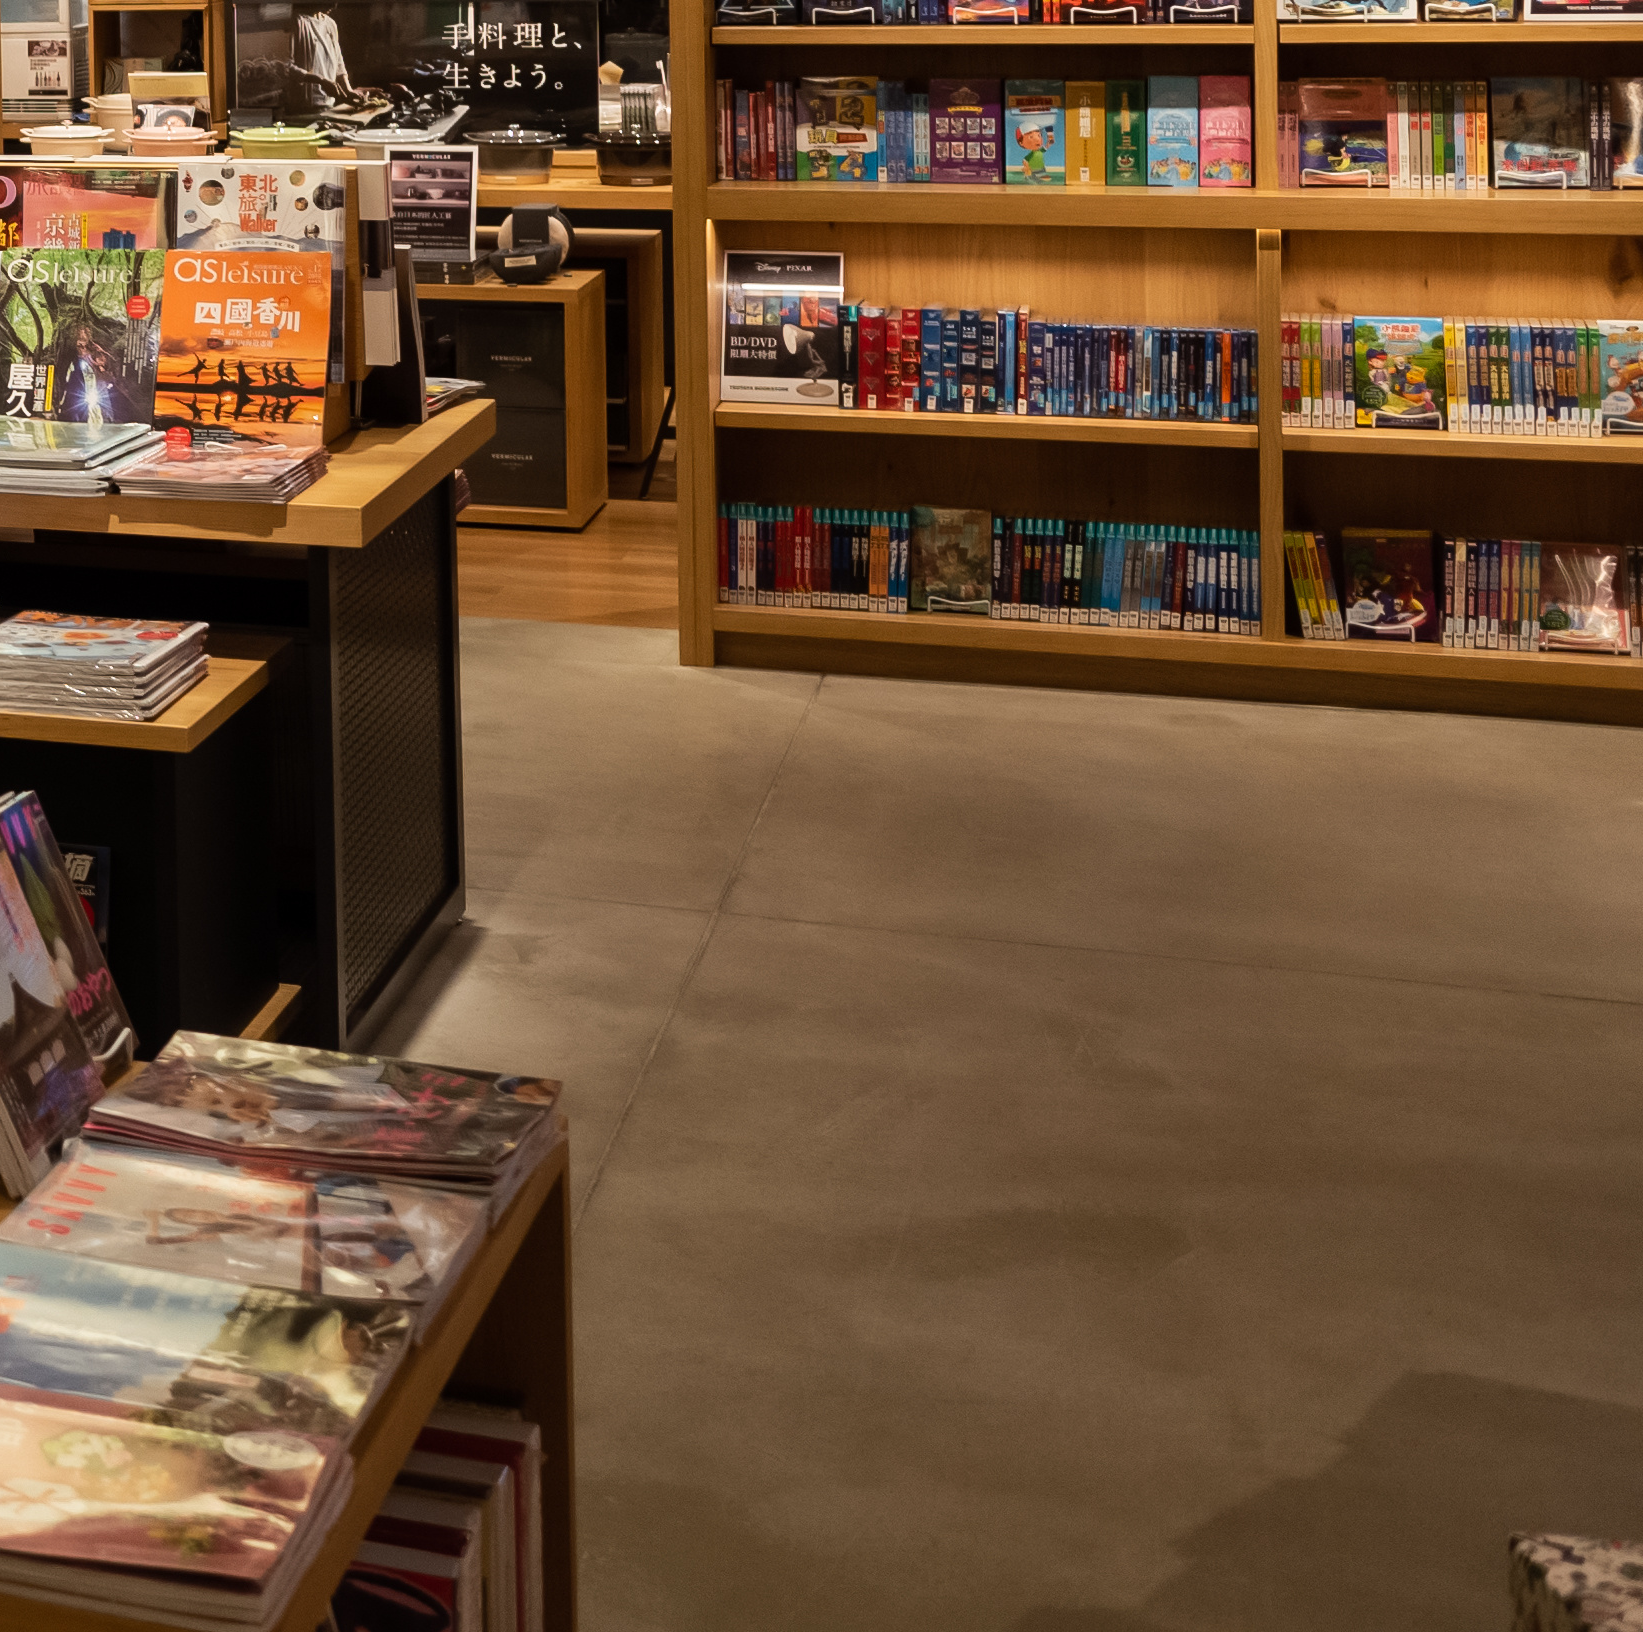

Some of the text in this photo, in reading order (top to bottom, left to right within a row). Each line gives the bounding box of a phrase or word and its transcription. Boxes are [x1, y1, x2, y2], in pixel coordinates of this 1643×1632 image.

[442, 62, 564, 90] 生きよう。
[238, 173, 279, 193] 東北
[238, 213, 279, 233] Walker
[194, 296, 301, 332] 四國香川
[730, 335, 777, 347] BD/DVD
